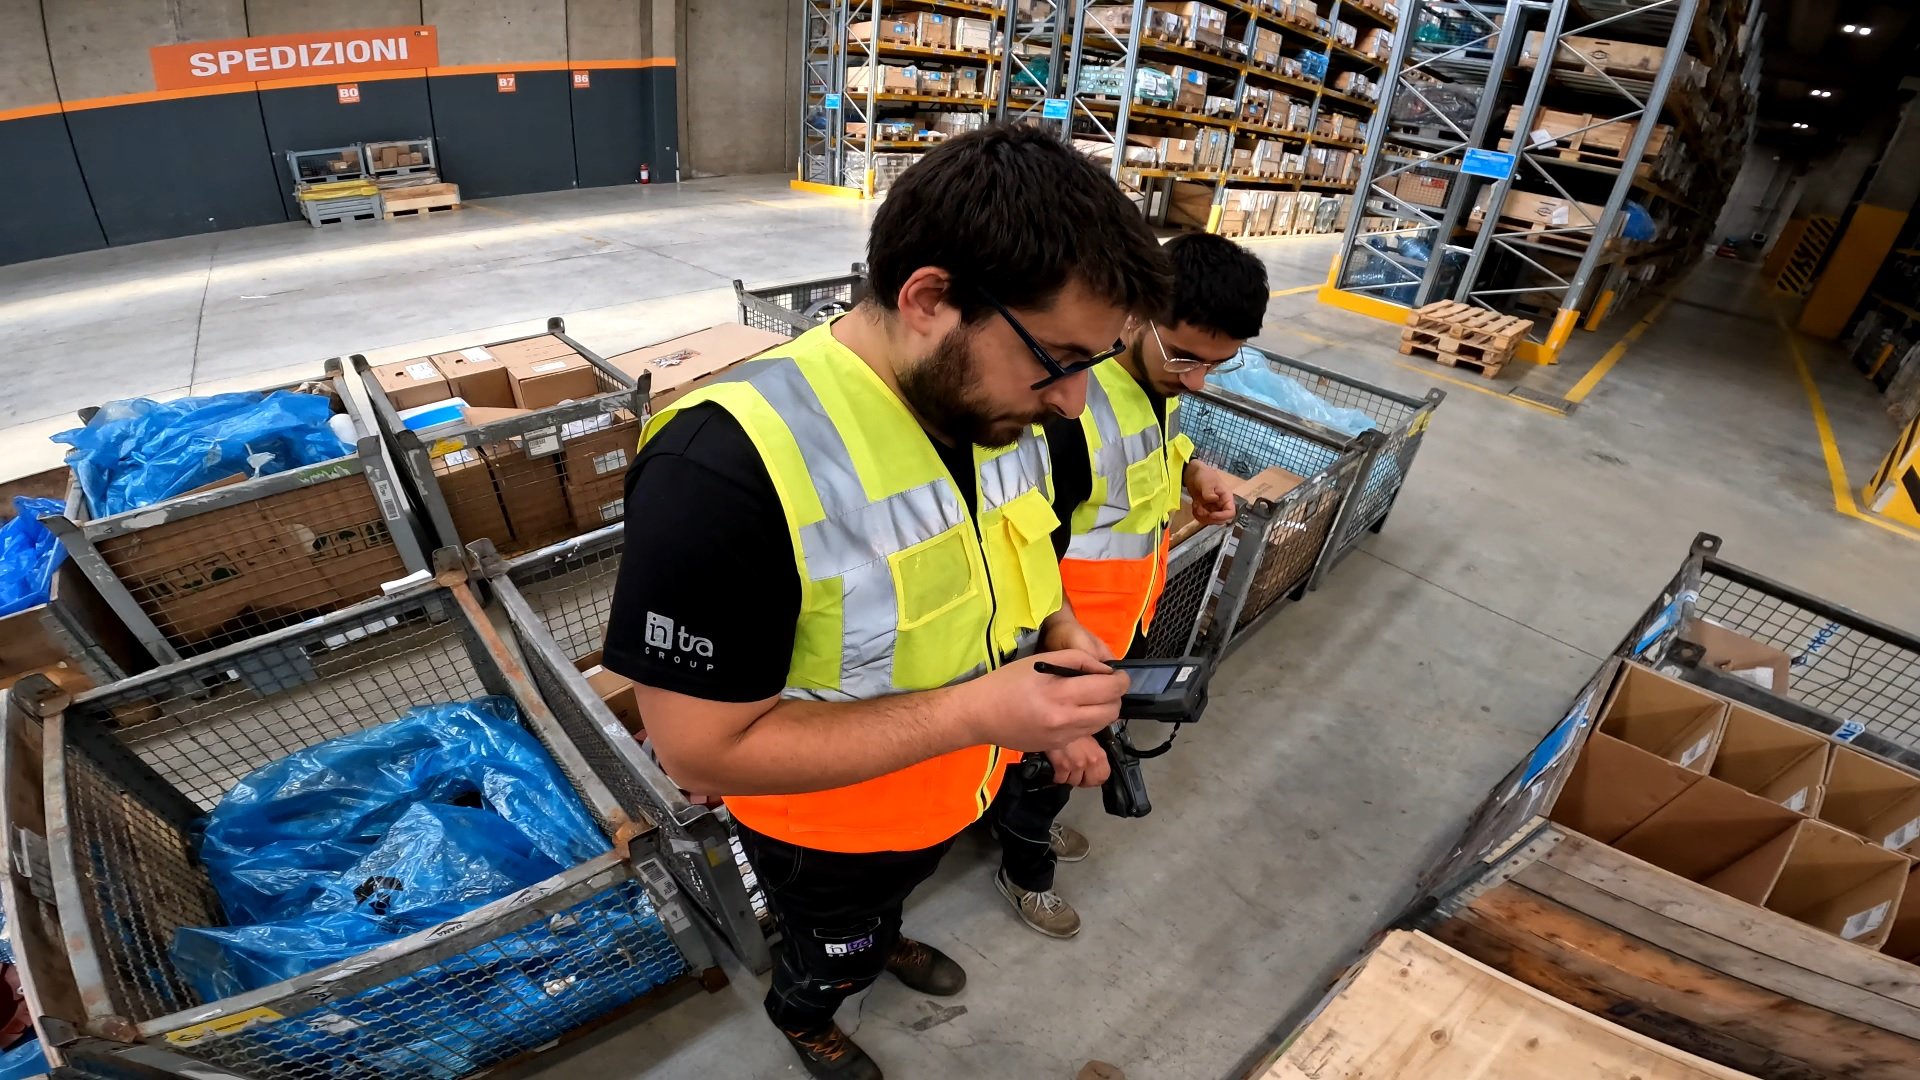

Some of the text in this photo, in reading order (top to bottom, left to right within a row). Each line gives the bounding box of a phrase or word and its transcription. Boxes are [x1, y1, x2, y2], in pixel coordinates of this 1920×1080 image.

[189, 37, 408, 77] SPEDIZIONI
[498, 77, 515, 87] B7
[574, 74, 589, 83] B6
[645, 647, 714, 671] GROUP
